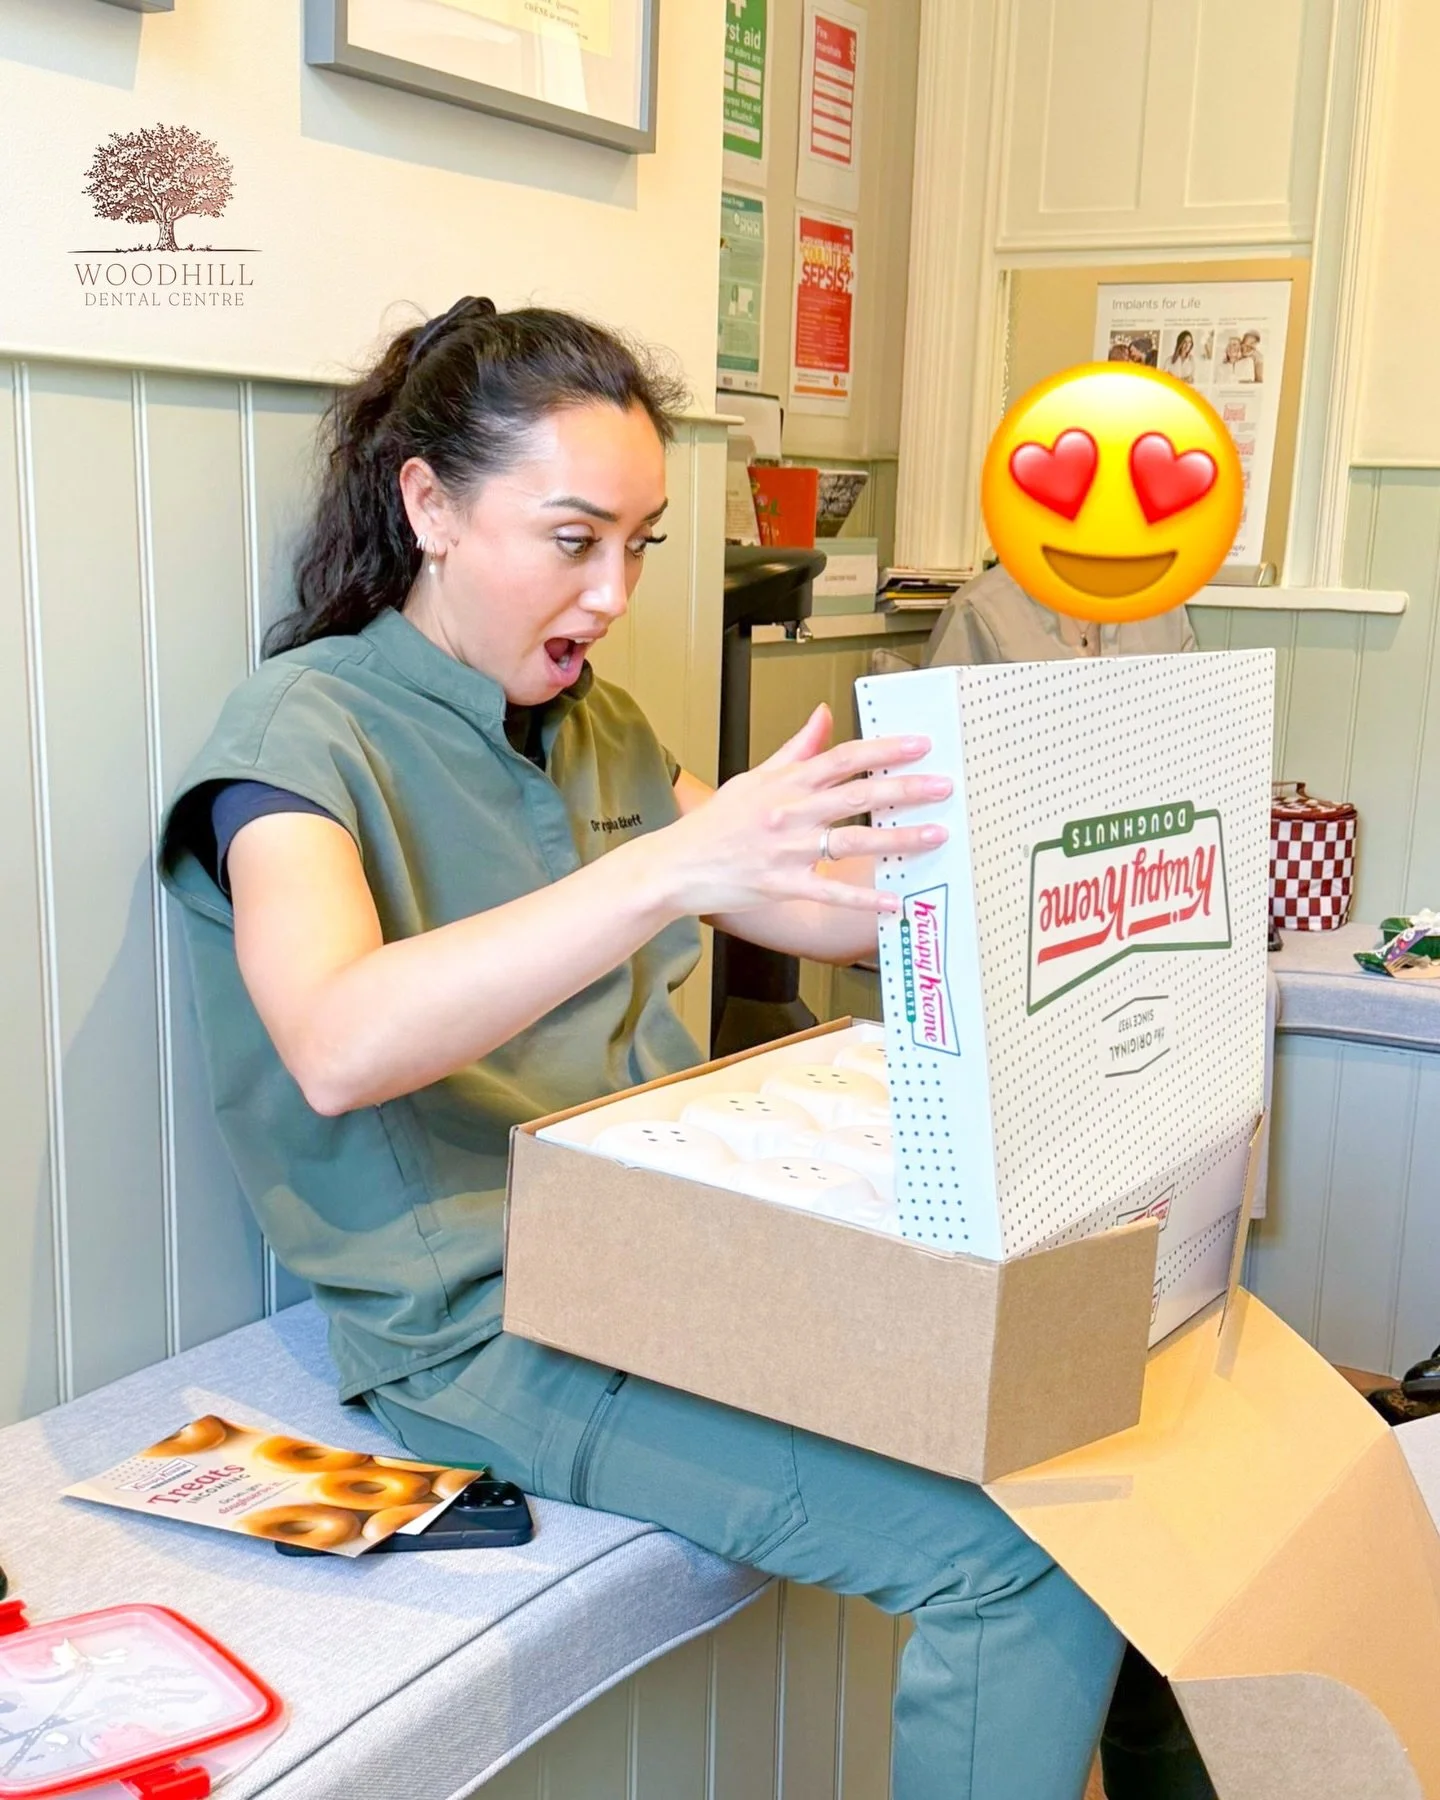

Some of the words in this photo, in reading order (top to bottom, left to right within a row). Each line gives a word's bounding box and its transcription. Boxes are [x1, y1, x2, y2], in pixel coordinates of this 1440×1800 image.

[744, 27, 761, 50] aid
[1112, 298, 1159, 311] Implants
[1162, 298, 1178, 310] for
[1180, 297, 1201, 309] Life
[1071, 808, 1187, 849] DOUGHNUTS
[1128, 844, 1217, 935] Krispy
[1038, 863, 1129, 962] Kreme
[913, 899, 941, 974] Krispy
[901, 925, 915, 1018] DOUGHNUTS
[918, 973, 946, 1046] Kreme
[1133, 1008, 1154, 1027] SINCE
[1109, 1031, 1153, 1061] ORIGINAL
[146, 1464, 245, 1505] Treats
[186, 1473, 251, 1504] INCOMING
